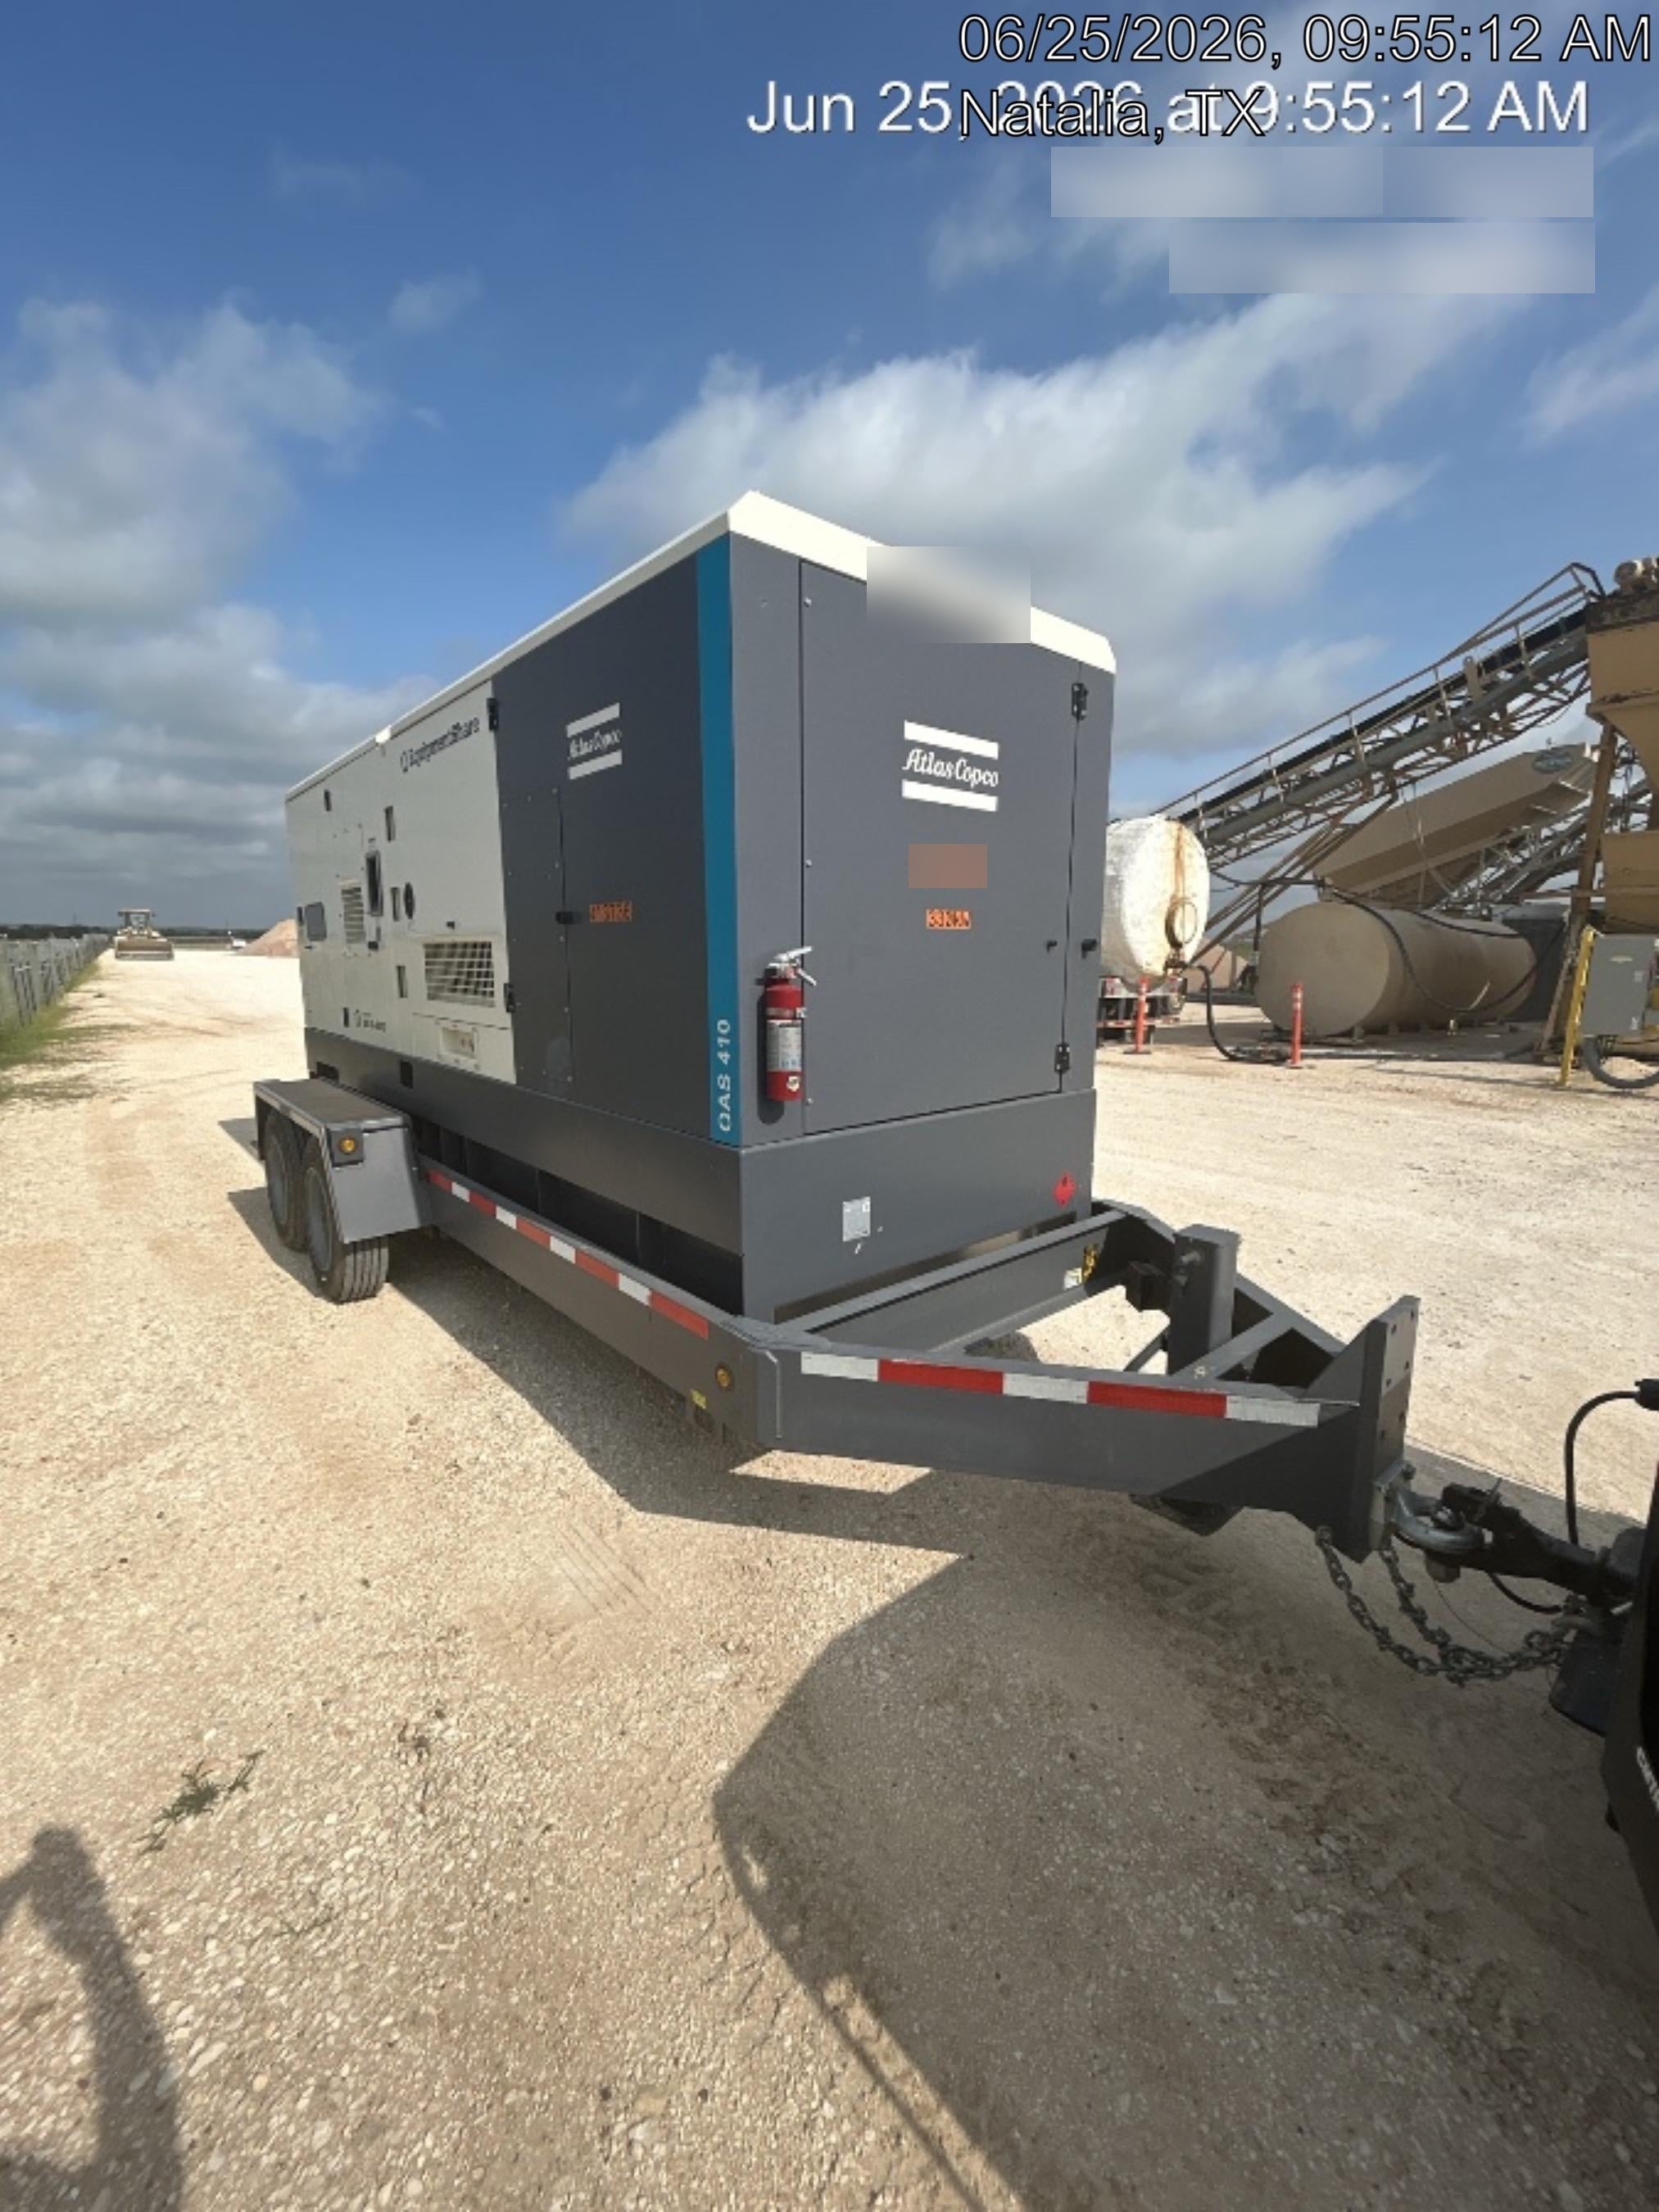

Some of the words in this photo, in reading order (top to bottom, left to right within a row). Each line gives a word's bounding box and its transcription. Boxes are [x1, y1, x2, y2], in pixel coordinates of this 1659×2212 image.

[902, 747, 954, 779] Atlas
[954, 756, 999, 789] Copco
[716, 1019, 731, 1065] 410
